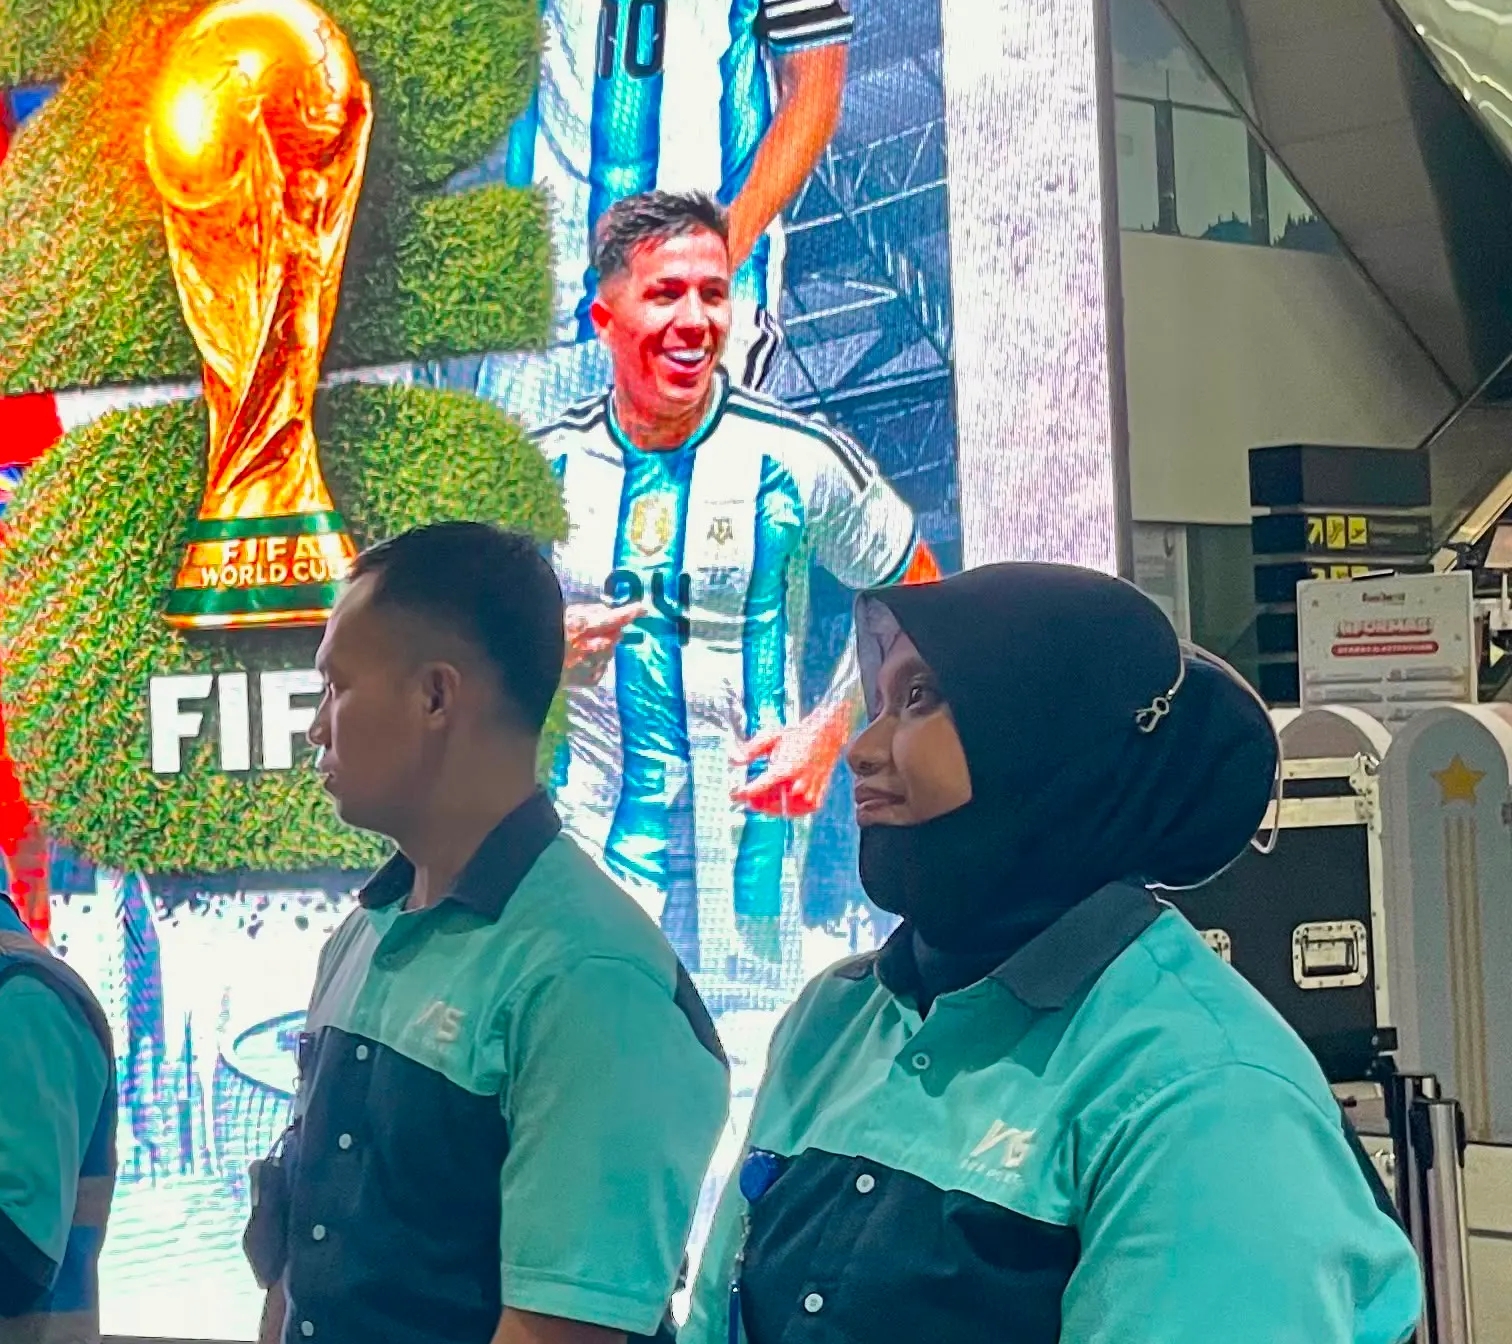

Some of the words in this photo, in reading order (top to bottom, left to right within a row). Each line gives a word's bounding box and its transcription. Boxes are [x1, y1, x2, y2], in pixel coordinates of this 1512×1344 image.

[221, 534, 323, 565] FIFA
[200, 561, 288, 587] WORLD
[149, 668, 328, 774] FIF
